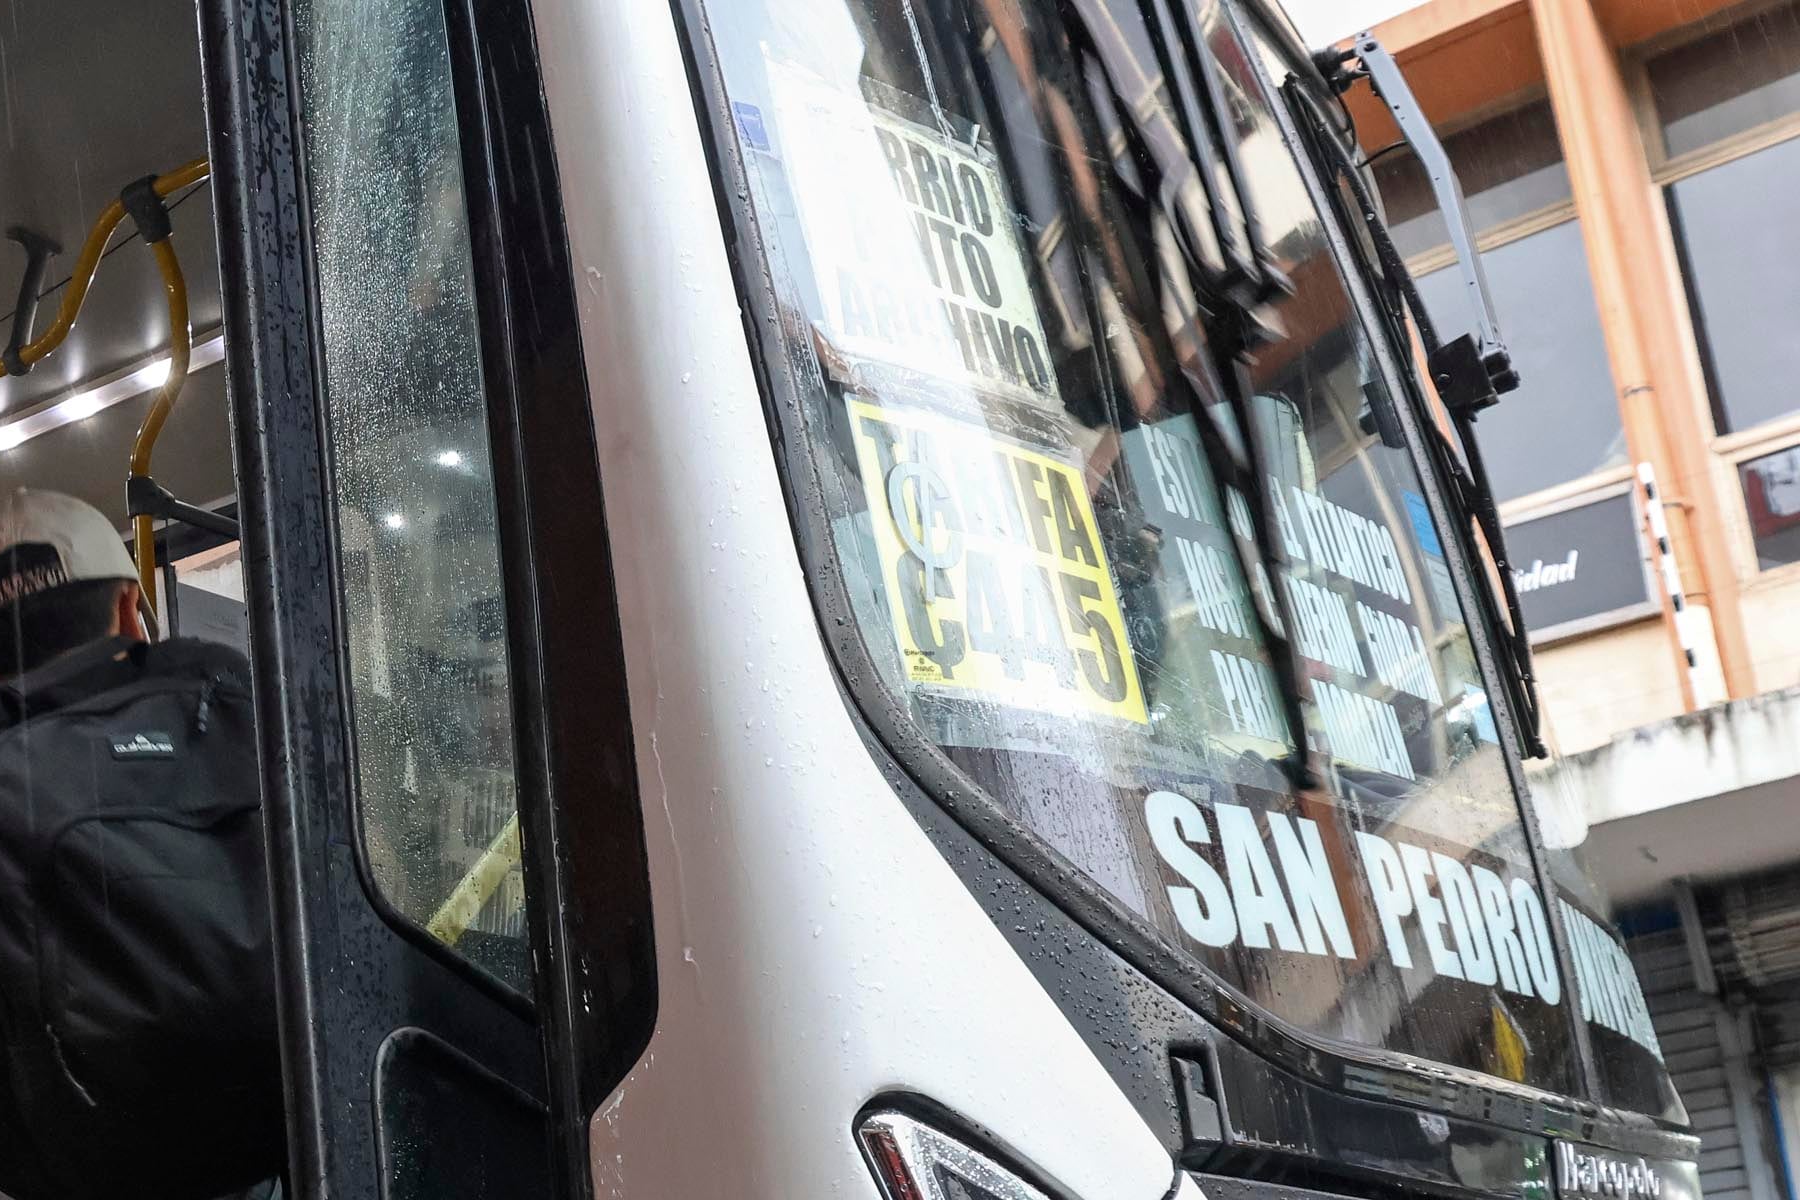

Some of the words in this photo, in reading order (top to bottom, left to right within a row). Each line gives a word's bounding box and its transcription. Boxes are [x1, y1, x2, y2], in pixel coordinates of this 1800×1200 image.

[1292, 485, 1411, 605] ATLANTICO
[1310, 678, 1416, 782] MORAZAN
[1145, 791, 1357, 960] SAN
[1355, 830, 1562, 1006] PEDRO
